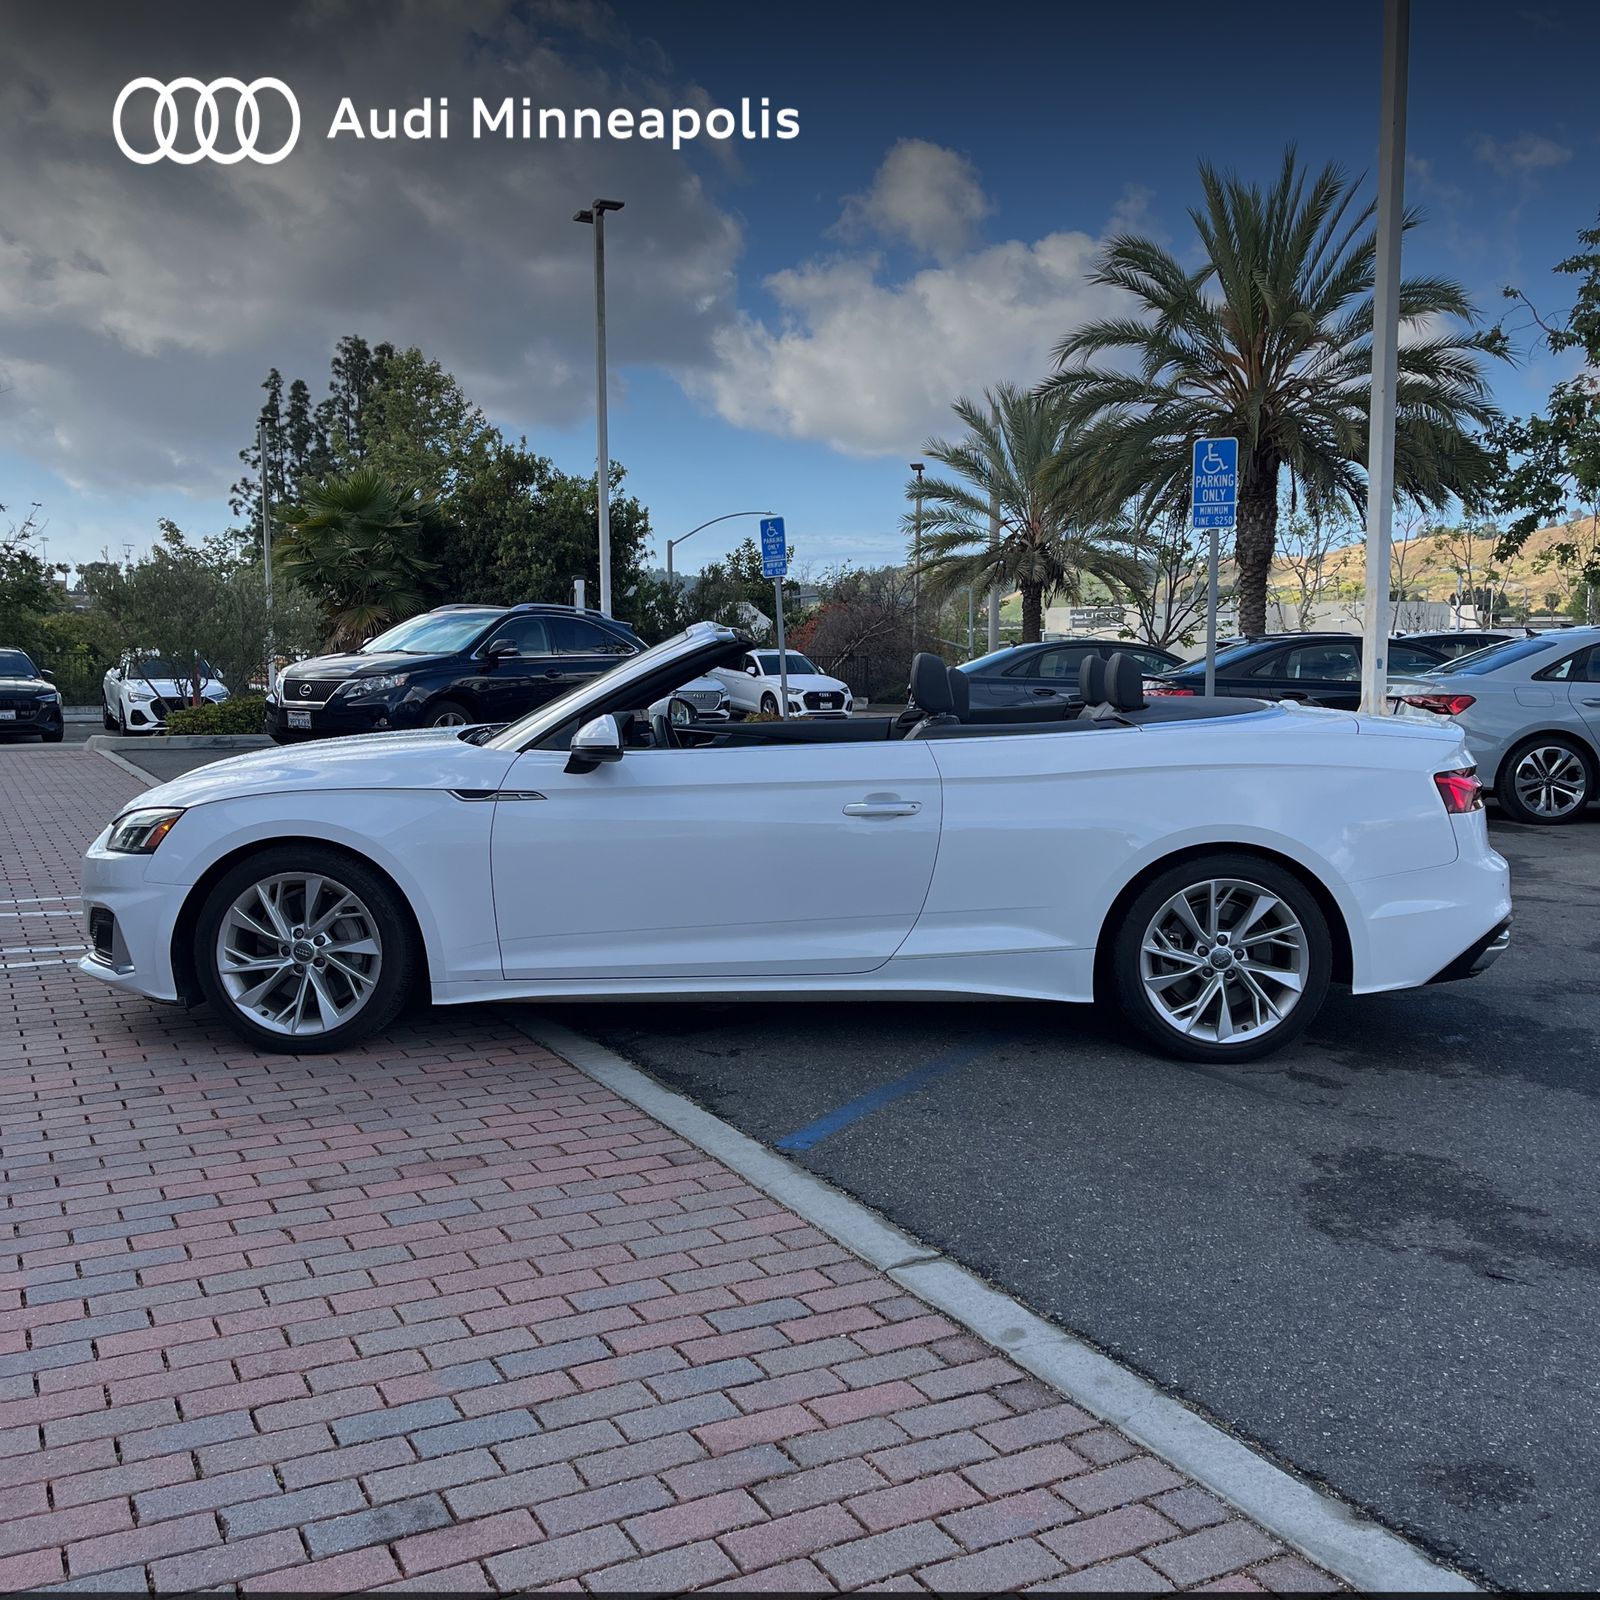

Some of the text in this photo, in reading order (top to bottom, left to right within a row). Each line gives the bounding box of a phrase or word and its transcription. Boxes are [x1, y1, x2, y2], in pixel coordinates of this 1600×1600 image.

[1195, 474, 1234, 488] PARKING
[1203, 489, 1226, 502] ONLY
[1200, 506, 1228, 516] MINIMUM
[1194, 517, 1209, 526] FINE
